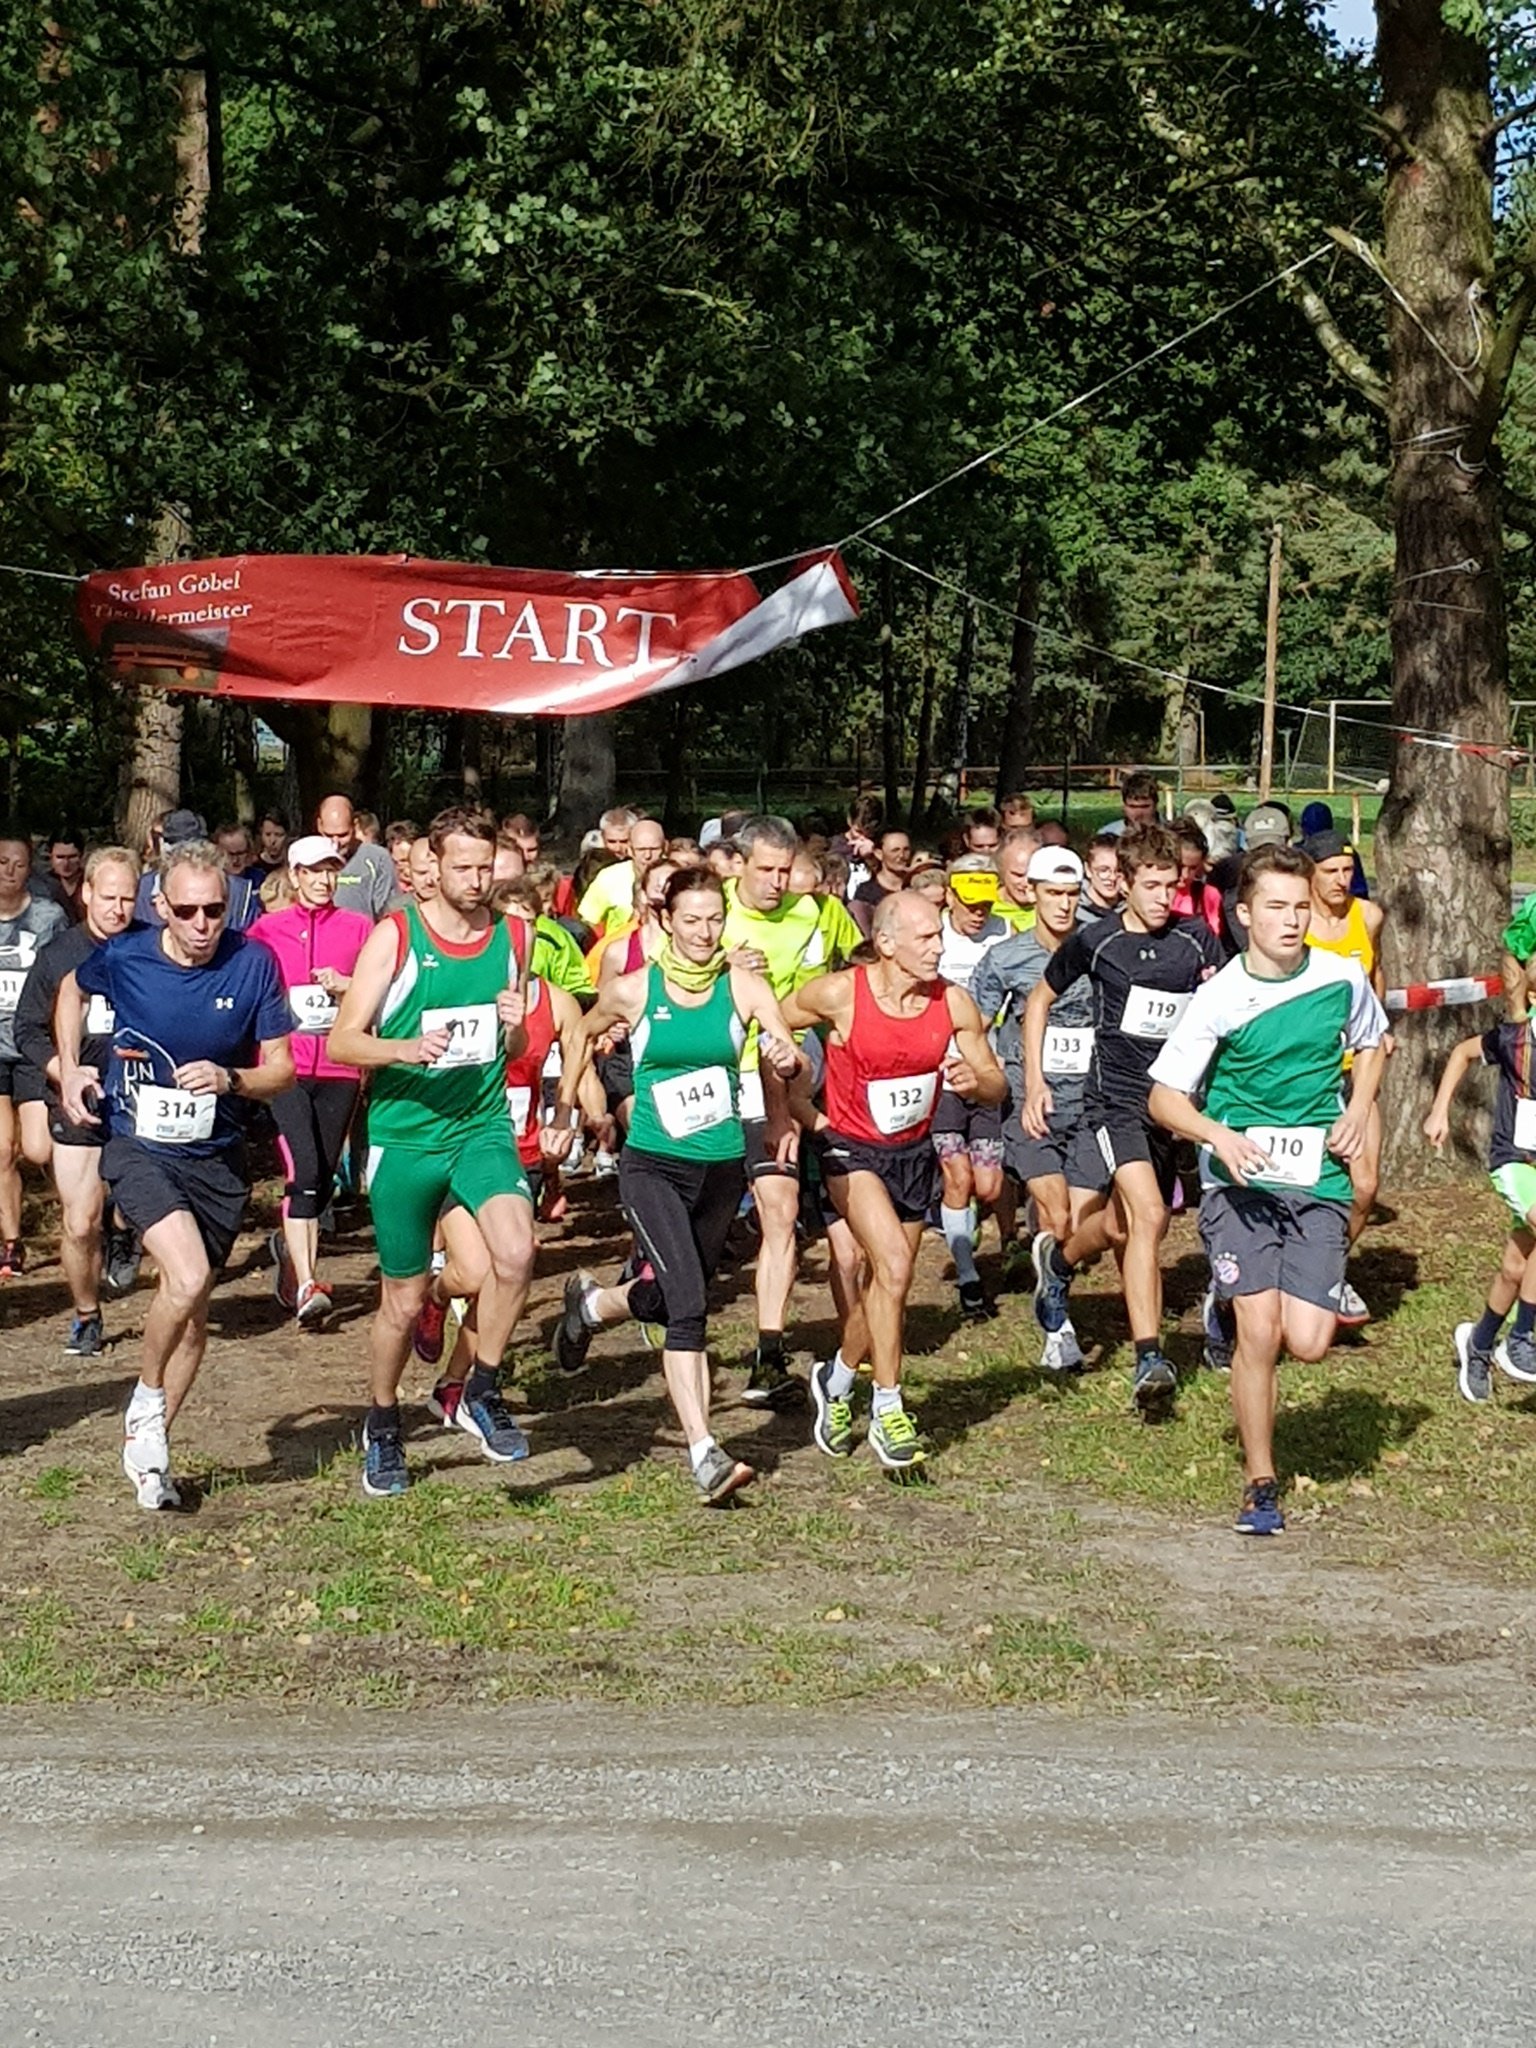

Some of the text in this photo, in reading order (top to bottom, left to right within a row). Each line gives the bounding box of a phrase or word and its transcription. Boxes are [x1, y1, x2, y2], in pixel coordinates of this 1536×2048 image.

[108, 570, 241, 602] Stefan Göbel
[397, 597, 678, 668] START
[0, 980, 17, 993] 11
[1147, 1001, 1177, 1018] 119
[1052, 1038, 1081, 1053] 133
[676, 1082, 715, 1108] 144
[889, 1087, 923, 1108] 132
[157, 1100, 197, 1119] 314
[1269, 1135, 1304, 1157] 110
